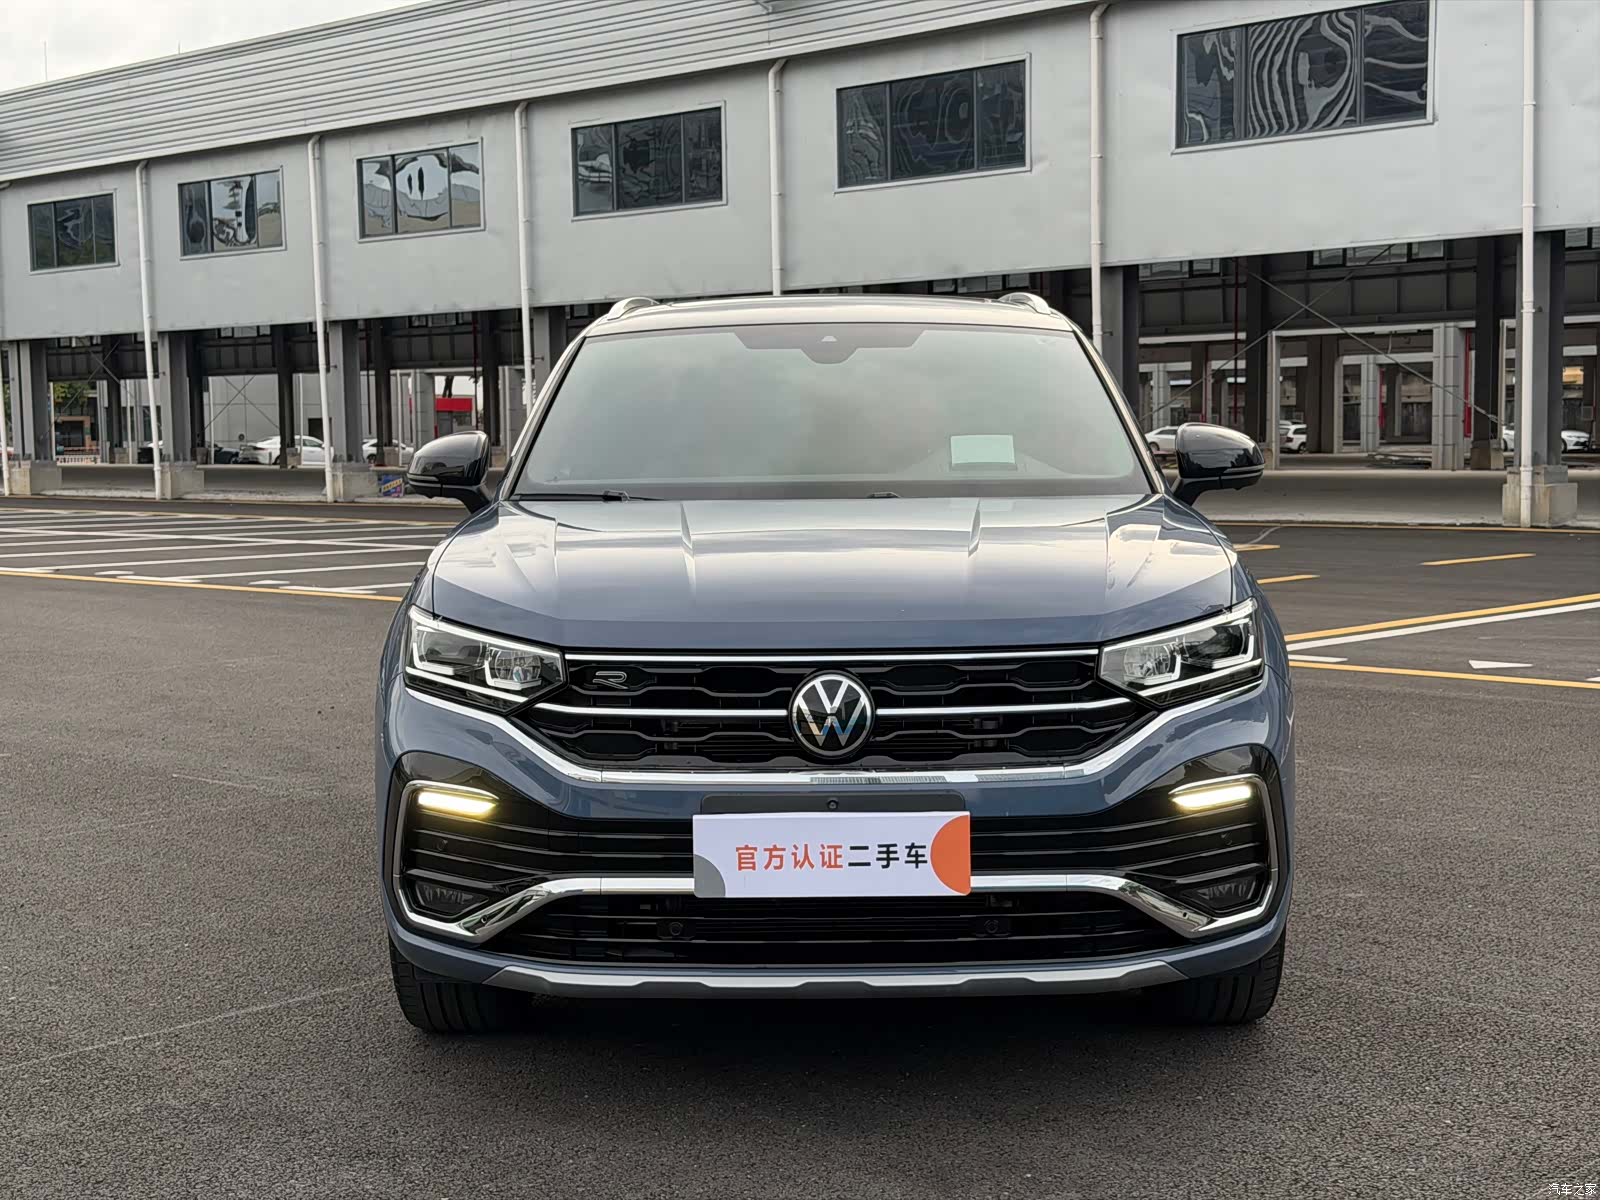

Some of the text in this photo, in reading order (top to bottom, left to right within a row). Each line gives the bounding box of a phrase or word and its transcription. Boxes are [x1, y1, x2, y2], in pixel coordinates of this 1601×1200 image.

[735, 843, 928, 872] 官方认证二手车
